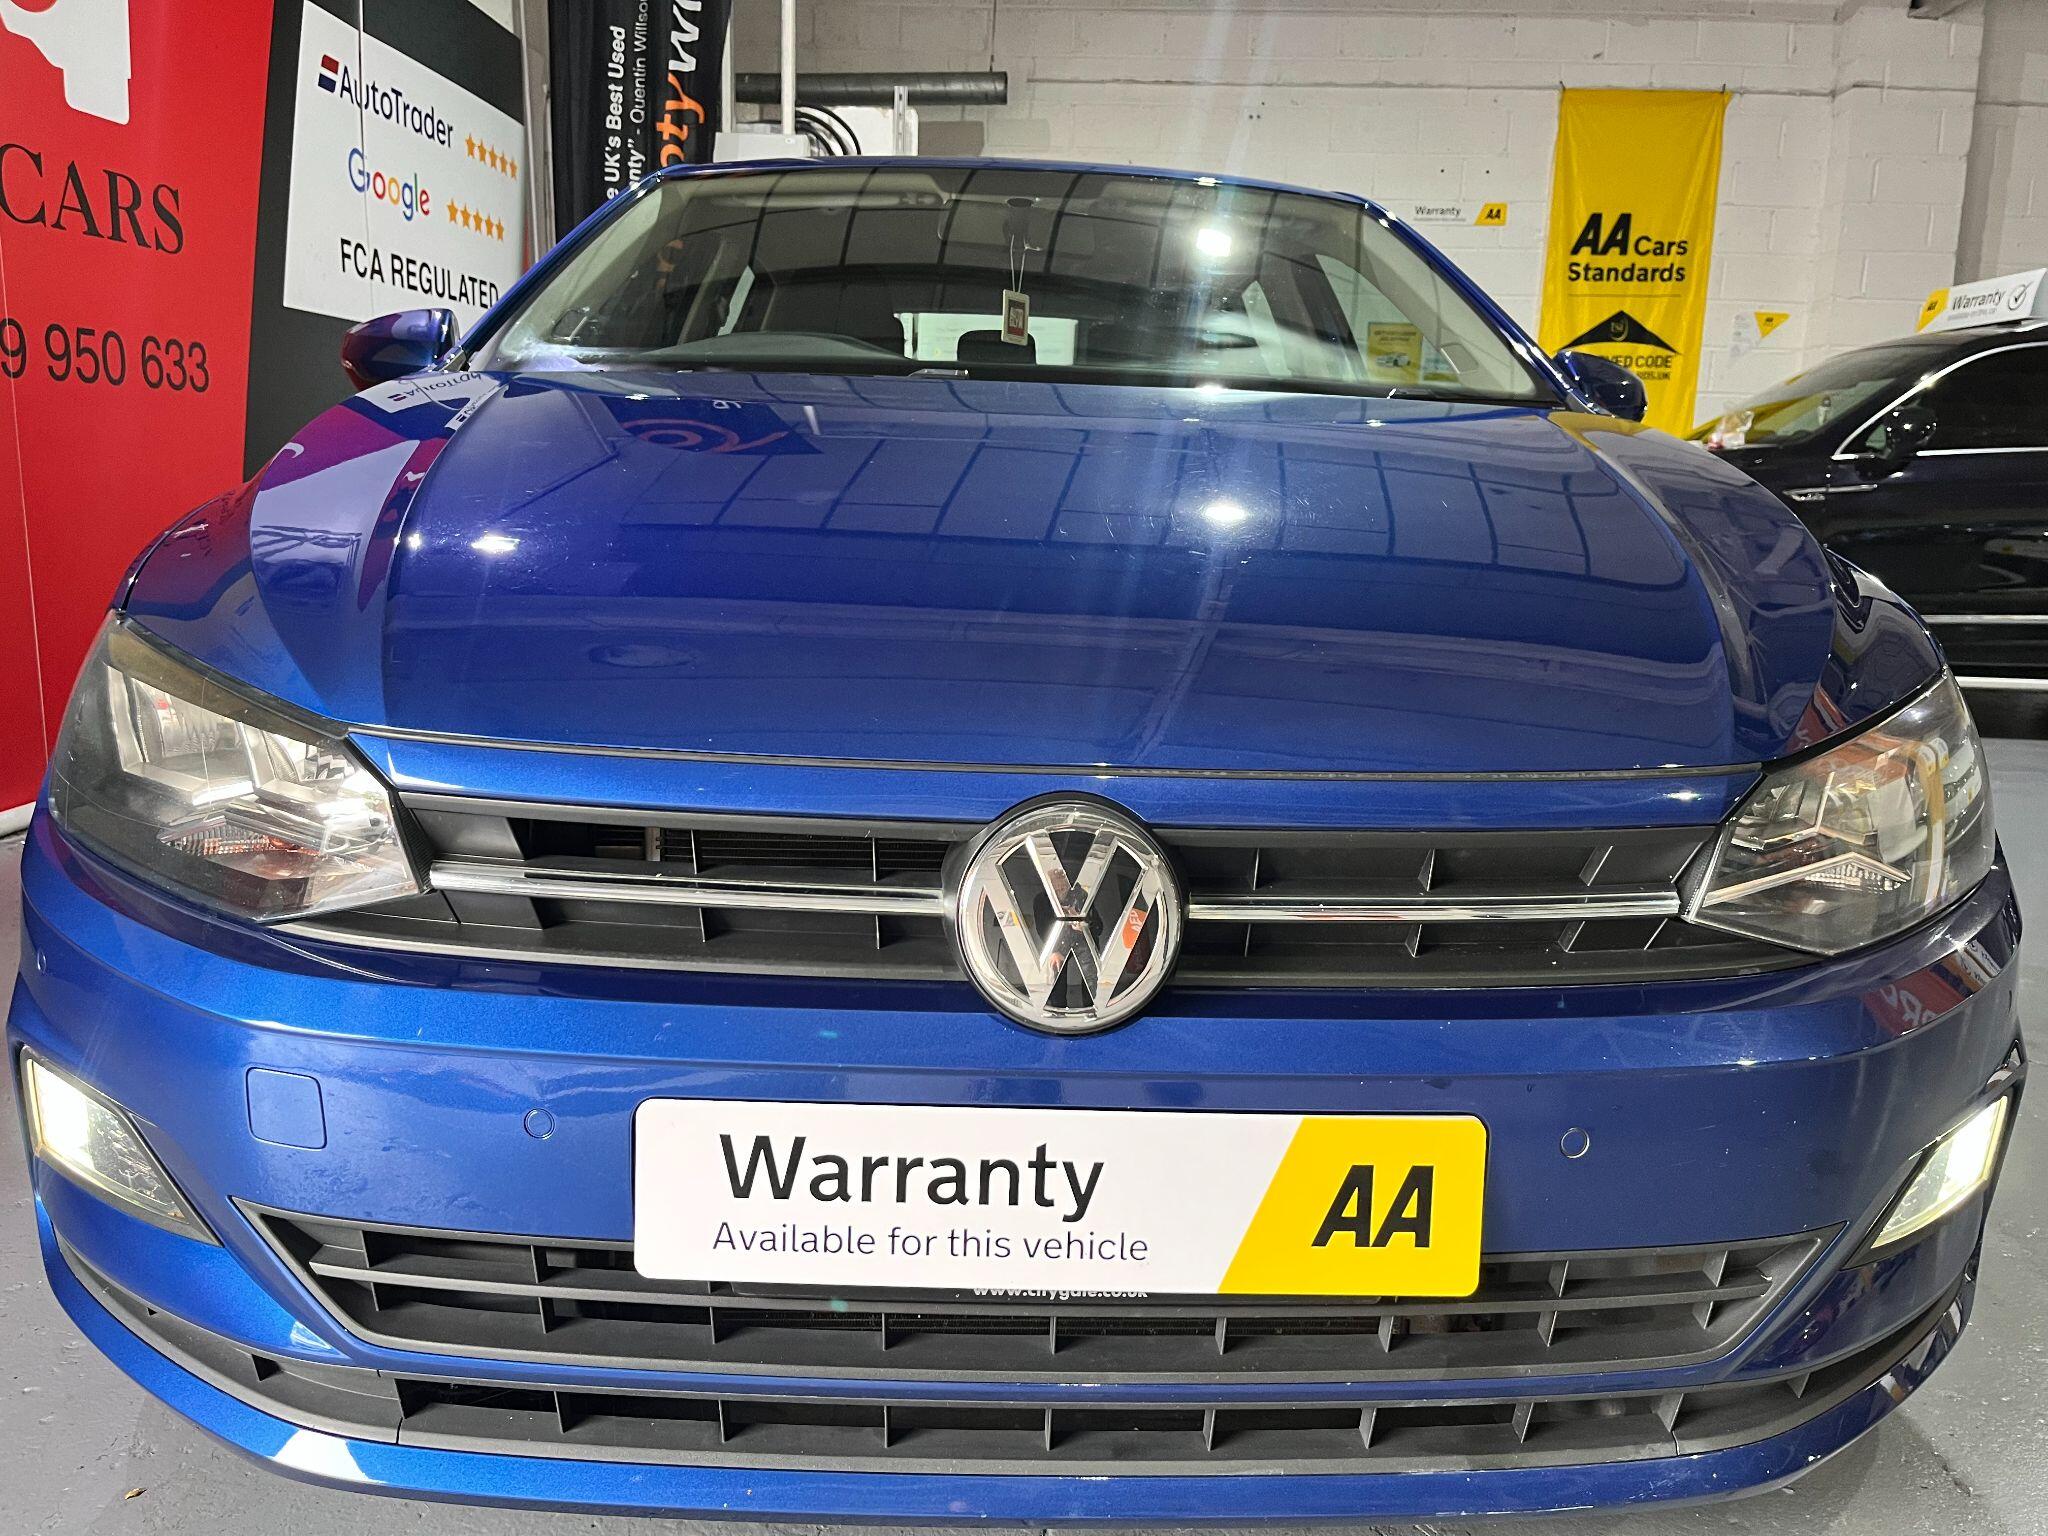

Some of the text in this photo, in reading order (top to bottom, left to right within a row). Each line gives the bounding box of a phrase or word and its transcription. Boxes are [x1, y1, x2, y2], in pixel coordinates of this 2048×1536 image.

[607, 25, 626, 79] Used
[633, 0, 649, 52] Willso
[340, 65, 453, 149] AutoTrader
[605, 83, 624, 131] Best
[629, 57, 647, 124] Quentin
[348, 147, 430, 221] Google
[604, 136, 621, 183] UK's
[627, 138, 646, 188] nty"
[0, 143, 184, 254] CARS
[1414, 206, 1502, 220] Warranty AA
[1570, 212, 1689, 256] AA Cars
[341, 238, 499, 309] FCA REGULATED
[1568, 262, 1686, 282] Standards
[1952, 287, 2007, 311] Warranty
[44, 323, 126, 386] 950
[141, 336, 210, 393] 633
[719, 1134, 1434, 1248] Warranty AA
[713, 1221, 1149, 1262] Available for this vehicle
